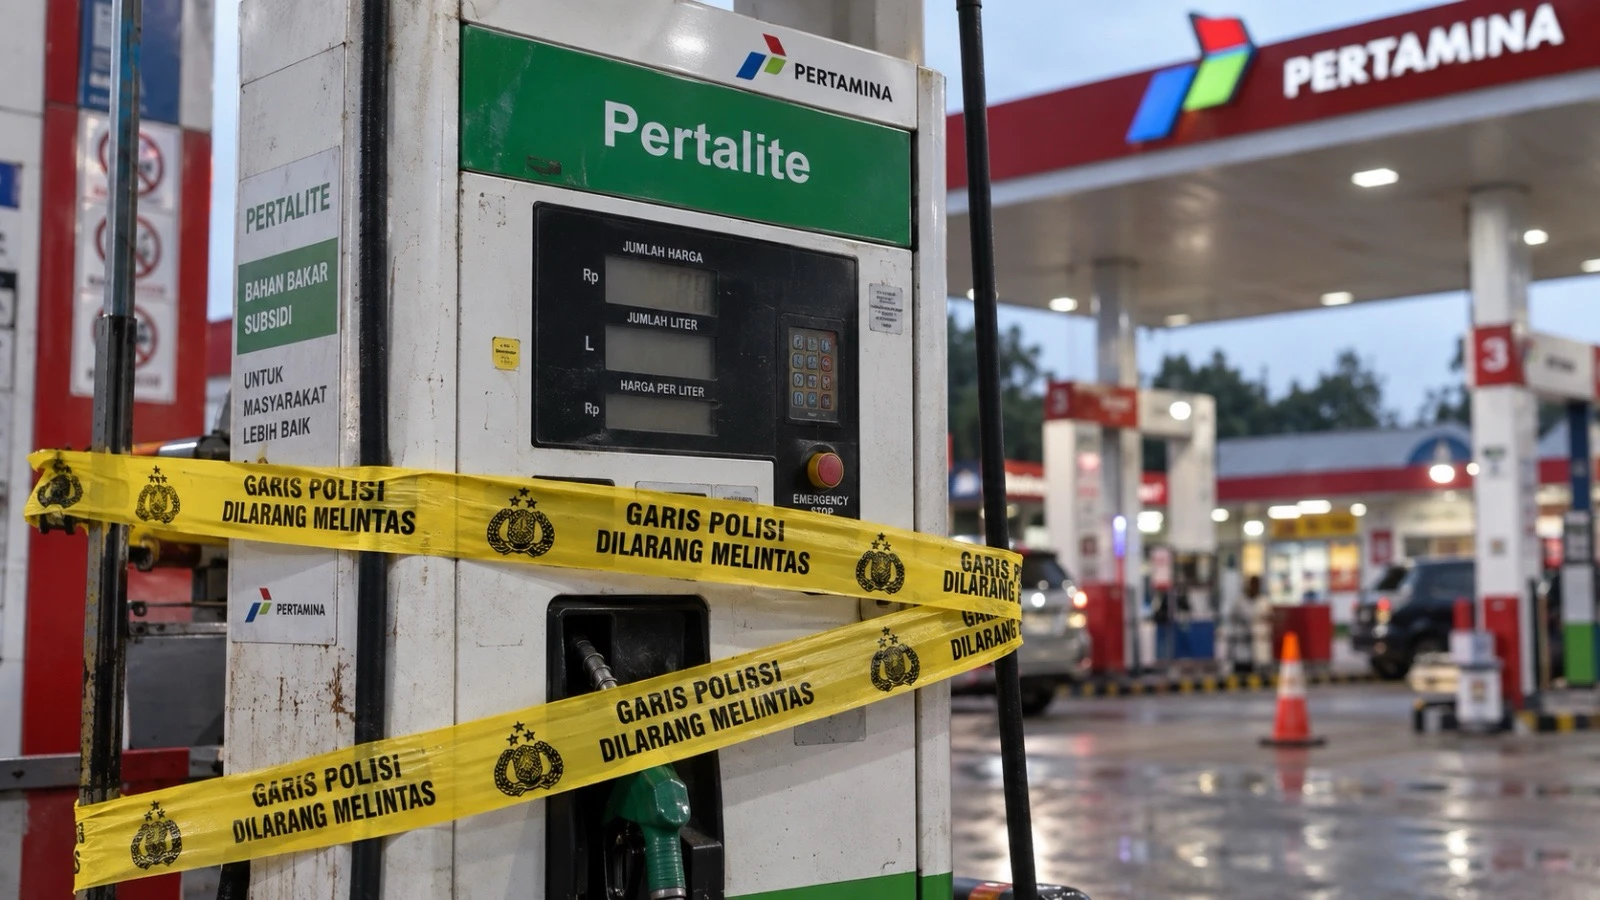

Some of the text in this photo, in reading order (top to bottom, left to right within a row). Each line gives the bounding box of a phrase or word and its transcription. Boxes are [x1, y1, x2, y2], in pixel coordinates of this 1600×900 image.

[1283, 2, 1564, 99] PERTAMINA
[795, 62, 893, 102] PERTAMINA
[604, 100, 811, 183] Pertalite
[246, 182, 331, 234] PERTALITE
[622, 241, 704, 263] JUMLAH HARGA
[245, 262, 328, 302] BAHAN BAKAR
[583, 268, 599, 285] Rp
[244, 305, 292, 335] SUBSIDI
[627, 312, 698, 331] JUMLAH LITER
[585, 335, 595, 352] L
[1481, 336, 1509, 373] 3
[244, 365, 284, 389] UNTUK
[620, 380, 705, 397] HARGA PER LITER
[243, 385, 327, 417] MASYARAKAT
[584, 402, 600, 417] Rp
[243, 417, 311, 445] LEBIH BAIK
[244, 475, 385, 502] GARIS POLISI
[793, 493, 849, 506] EMERGENCY
[221, 500, 416, 535] DILARANG MELINTAS
[626, 502, 786, 542] GARIS POLISI
[596, 530, 811, 575] DILARANG MELINTAS
[961, 551, 1010, 580] GARIS
[943, 570, 1015, 603] DILARANG
[276, 603, 326, 616] PERTAMINA
[951, 618, 1017, 661] DILARANG
[616, 686, 689, 725] GARIS
[599, 713, 706, 763] DILARANG
[252, 754, 402, 808] GARIS POLISI
[232, 780, 436, 844] DILARANG MELINTAS
